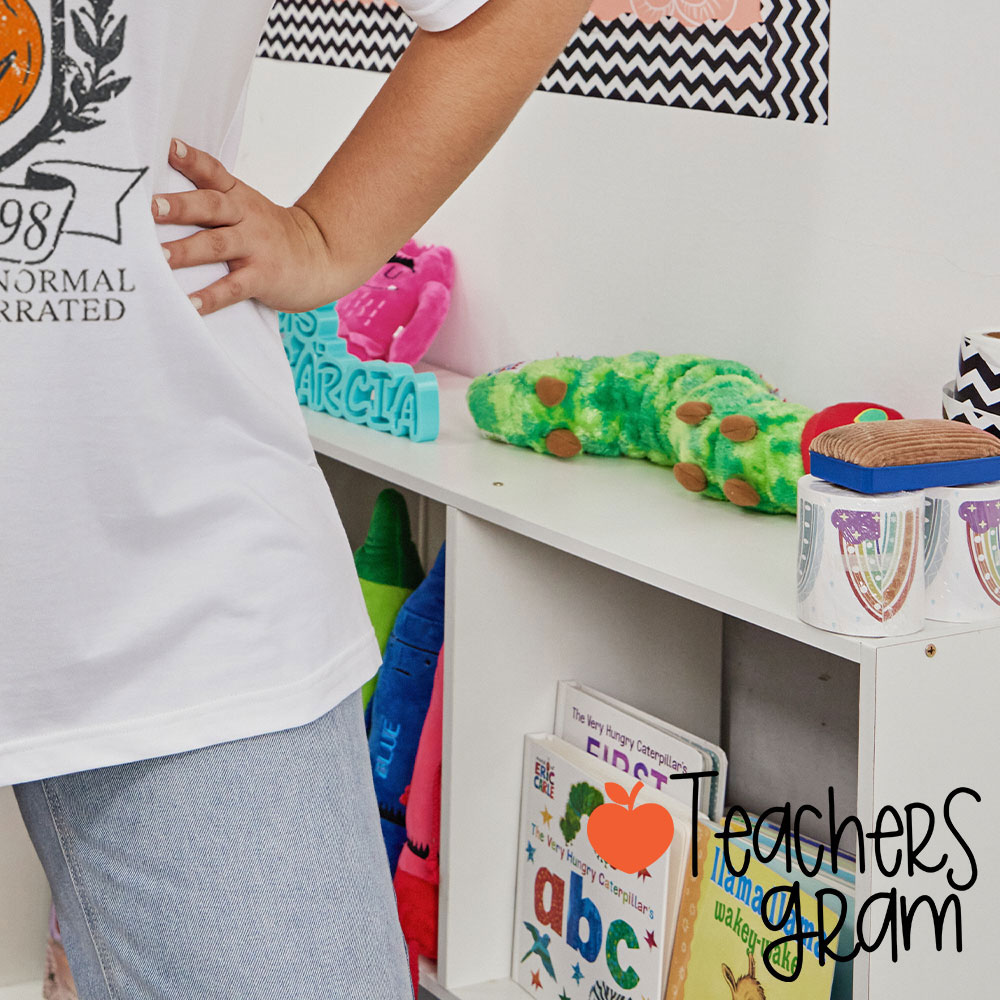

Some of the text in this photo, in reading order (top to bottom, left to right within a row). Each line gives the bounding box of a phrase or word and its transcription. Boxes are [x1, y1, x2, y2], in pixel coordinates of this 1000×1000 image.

[375, 723, 401, 779] BLUE
[572, 706, 688, 775] The Very Hungry Caterpillar's
[533, 775, 555, 800] CARLE
[535, 761, 555, 786] ERIC
[531, 822, 655, 921] The Very Hungry Caterpillar's
[533, 866, 641, 991] abc
